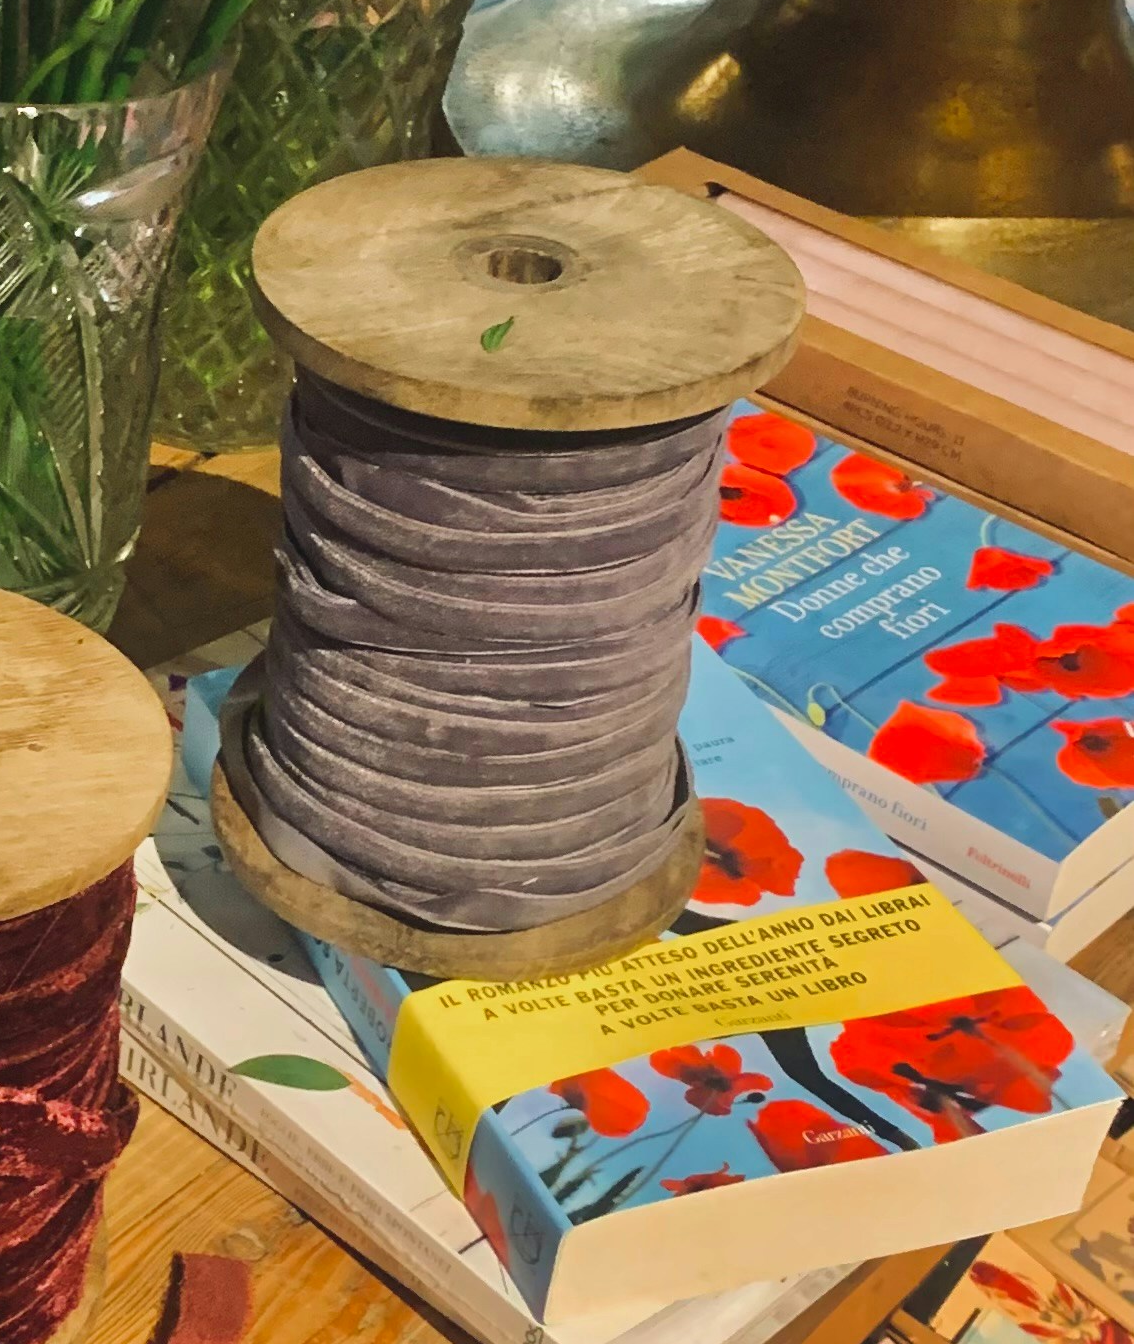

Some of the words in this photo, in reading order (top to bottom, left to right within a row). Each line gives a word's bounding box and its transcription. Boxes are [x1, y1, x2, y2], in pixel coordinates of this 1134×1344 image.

[702, 512, 839, 581] VANESSA
[722, 517, 882, 610] MONTFORT
[767, 571, 867, 623] Donne
[859, 544, 910, 576] che
[819, 566, 942, 639] comprano
[878, 599, 952, 639] fiori
[692, 737, 735, 752] paura
[826, 768, 888, 809] mprano
[891, 799, 929, 831] fiori
[438, 994, 462, 1009] IL
[466, 976, 571, 1002] ROMANZO
[620, 946, 698, 973] ATTESO
[702, 916, 815, 955] DELL'ANNO
[818, 908, 856, 927] DAI
[859, 893, 932, 919] LIBRAI
[483, 1007, 499, 1021] A
[503, 994, 571, 1015] VOLTE
[574, 978, 647, 1004] BASTA
[650, 971, 682, 989] UN
[686, 939, 825, 981] INGREDIENTE
[828, 918, 922, 949] SEGRETO
[595, 998, 639, 1017] PER
[642, 979, 733, 1006] DONARE
[600, 1023, 617, 1036] A
[619, 1005, 690, 1030] VOLTE
[692, 994, 764, 1013] BASTA
[766, 986, 800, 1002] UN
[803, 970, 868, 997] LIBRO
[714, 1008, 793, 1027] Garzanti
[801, 1119, 876, 1145] Garzanti
